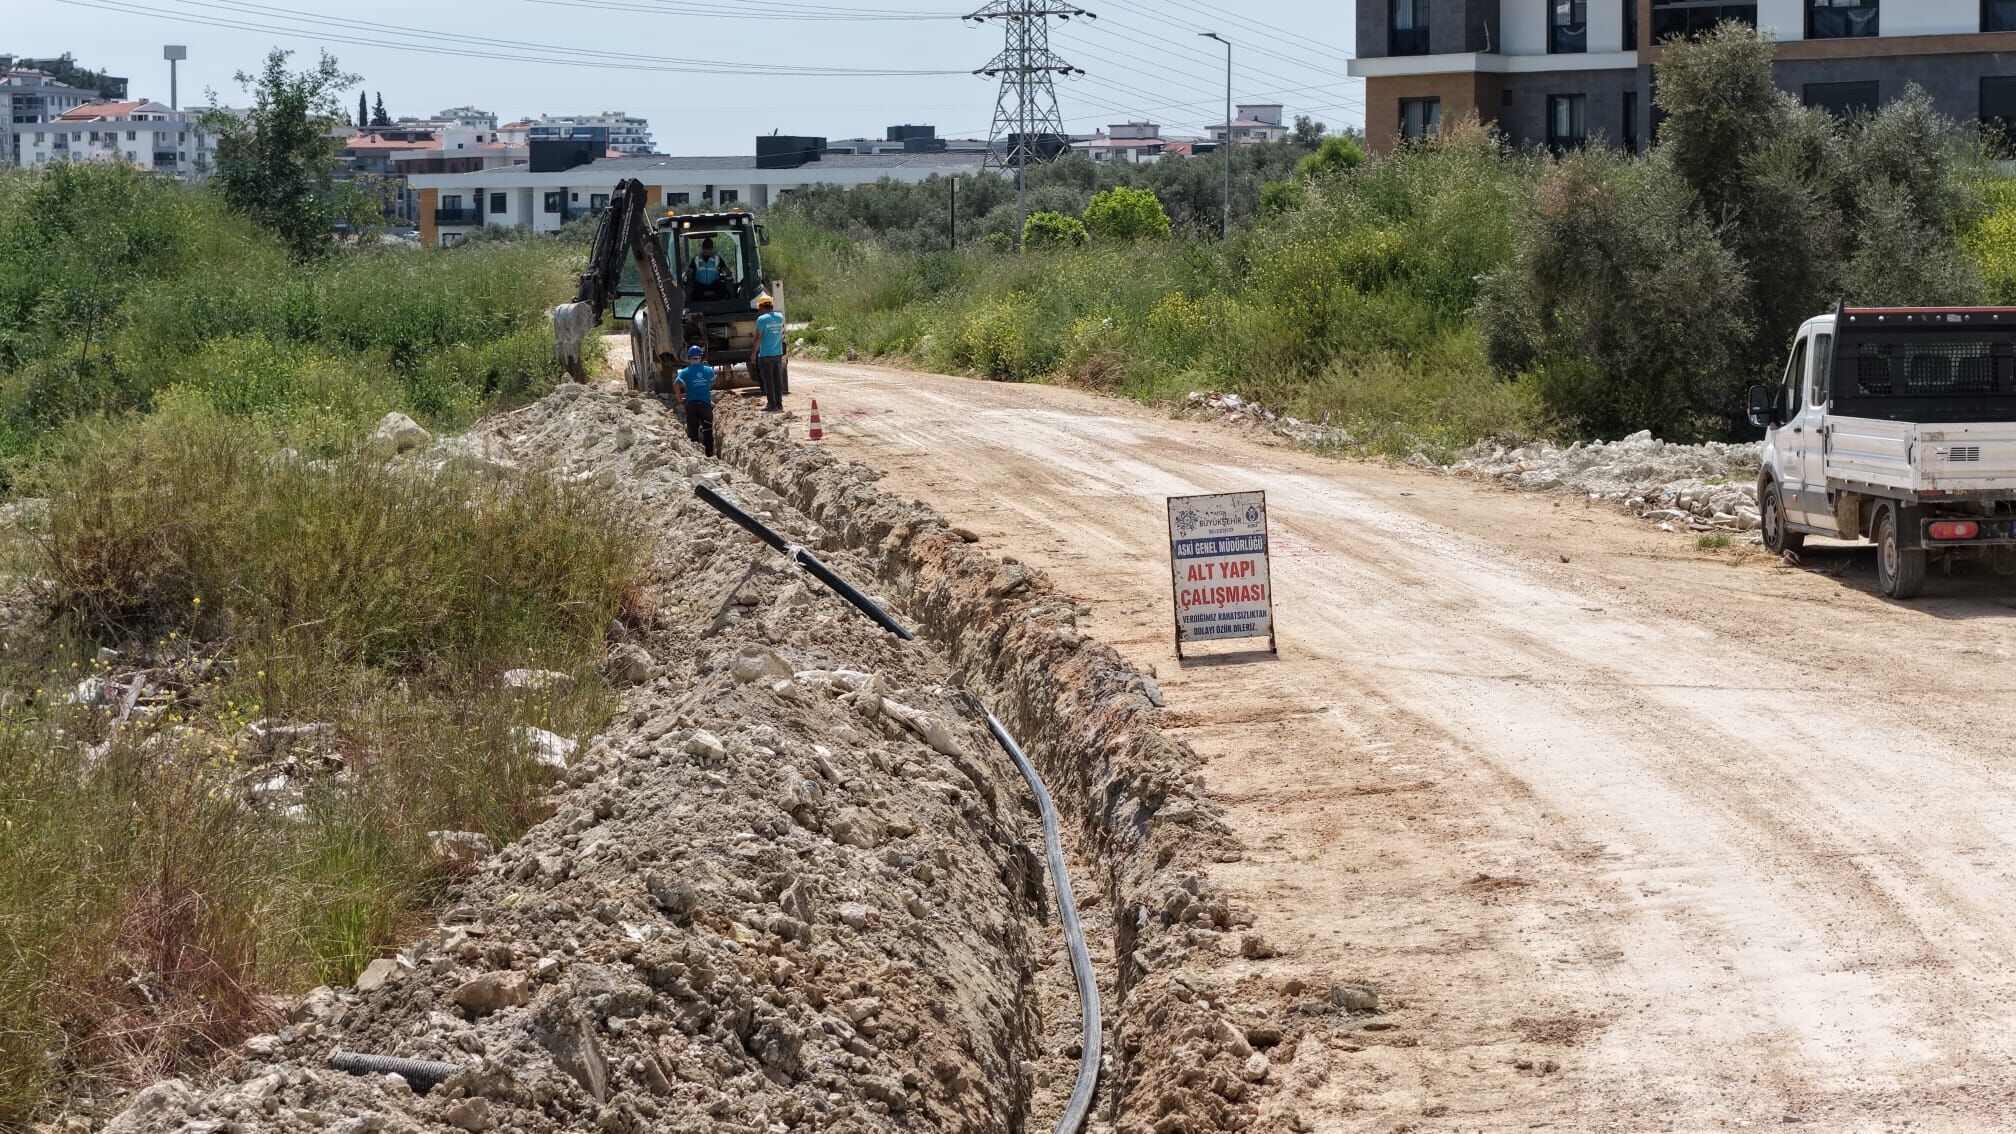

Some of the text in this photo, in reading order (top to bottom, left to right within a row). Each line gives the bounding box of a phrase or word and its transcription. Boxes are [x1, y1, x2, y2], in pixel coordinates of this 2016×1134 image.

[1177, 536, 1263, 556] ASKİ GENEL MÜDÜRLÜĞÜ
[1187, 560, 1255, 581] ALT YAPI
[1180, 584, 1266, 611] ÇALIŞMASI
[1193, 626, 1215, 636] DOLAYI
[1216, 624, 1232, 635] ÖZÜR
